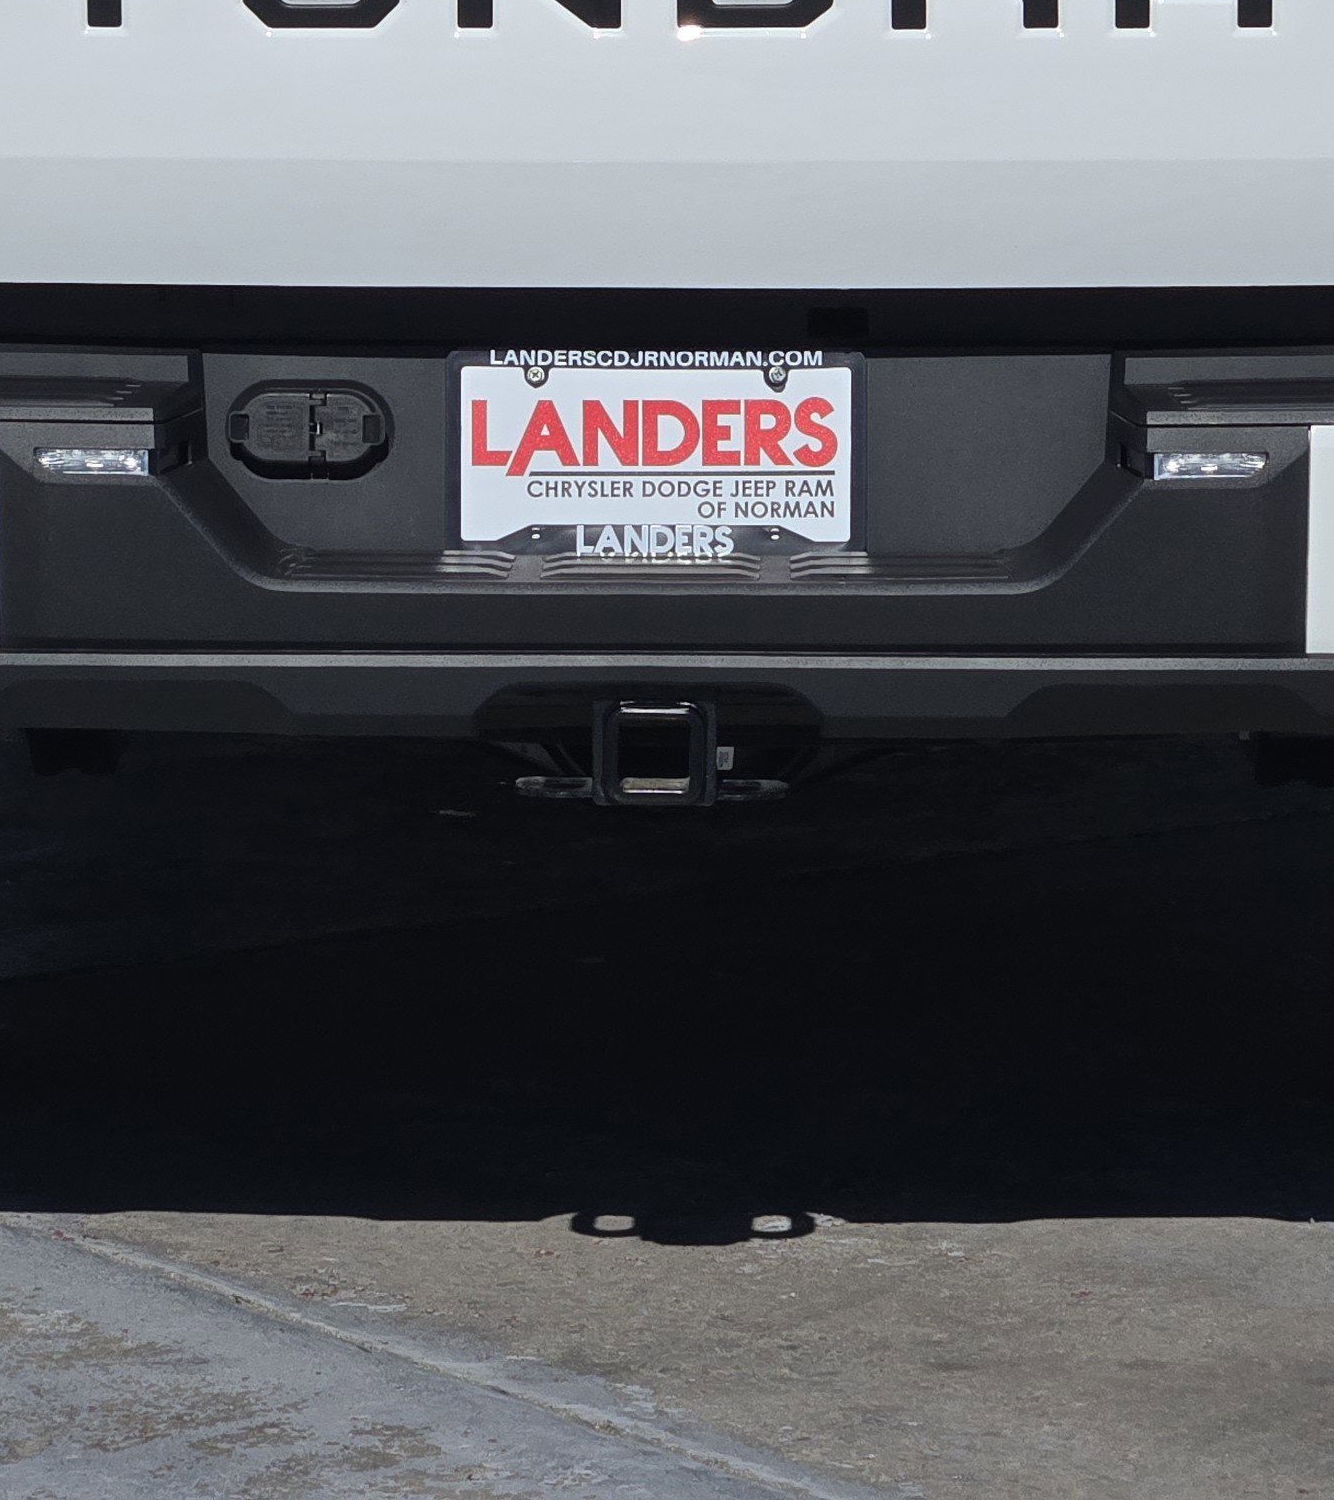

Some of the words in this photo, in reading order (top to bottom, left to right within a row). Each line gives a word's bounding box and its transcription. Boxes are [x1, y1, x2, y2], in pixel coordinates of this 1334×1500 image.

[489, 350, 823, 367] LANDERSCDJRNORMAN.COM
[471, 396, 838, 477] LANDERS
[526, 480, 634, 498] CHRYSLER
[642, 480, 723, 498] DODGE
[730, 480, 776, 498] JEEP
[786, 480, 835, 498] RAM
[697, 501, 727, 519] OF
[735, 501, 835, 519] NORMAN
[575, 524, 735, 558] LANDERS
